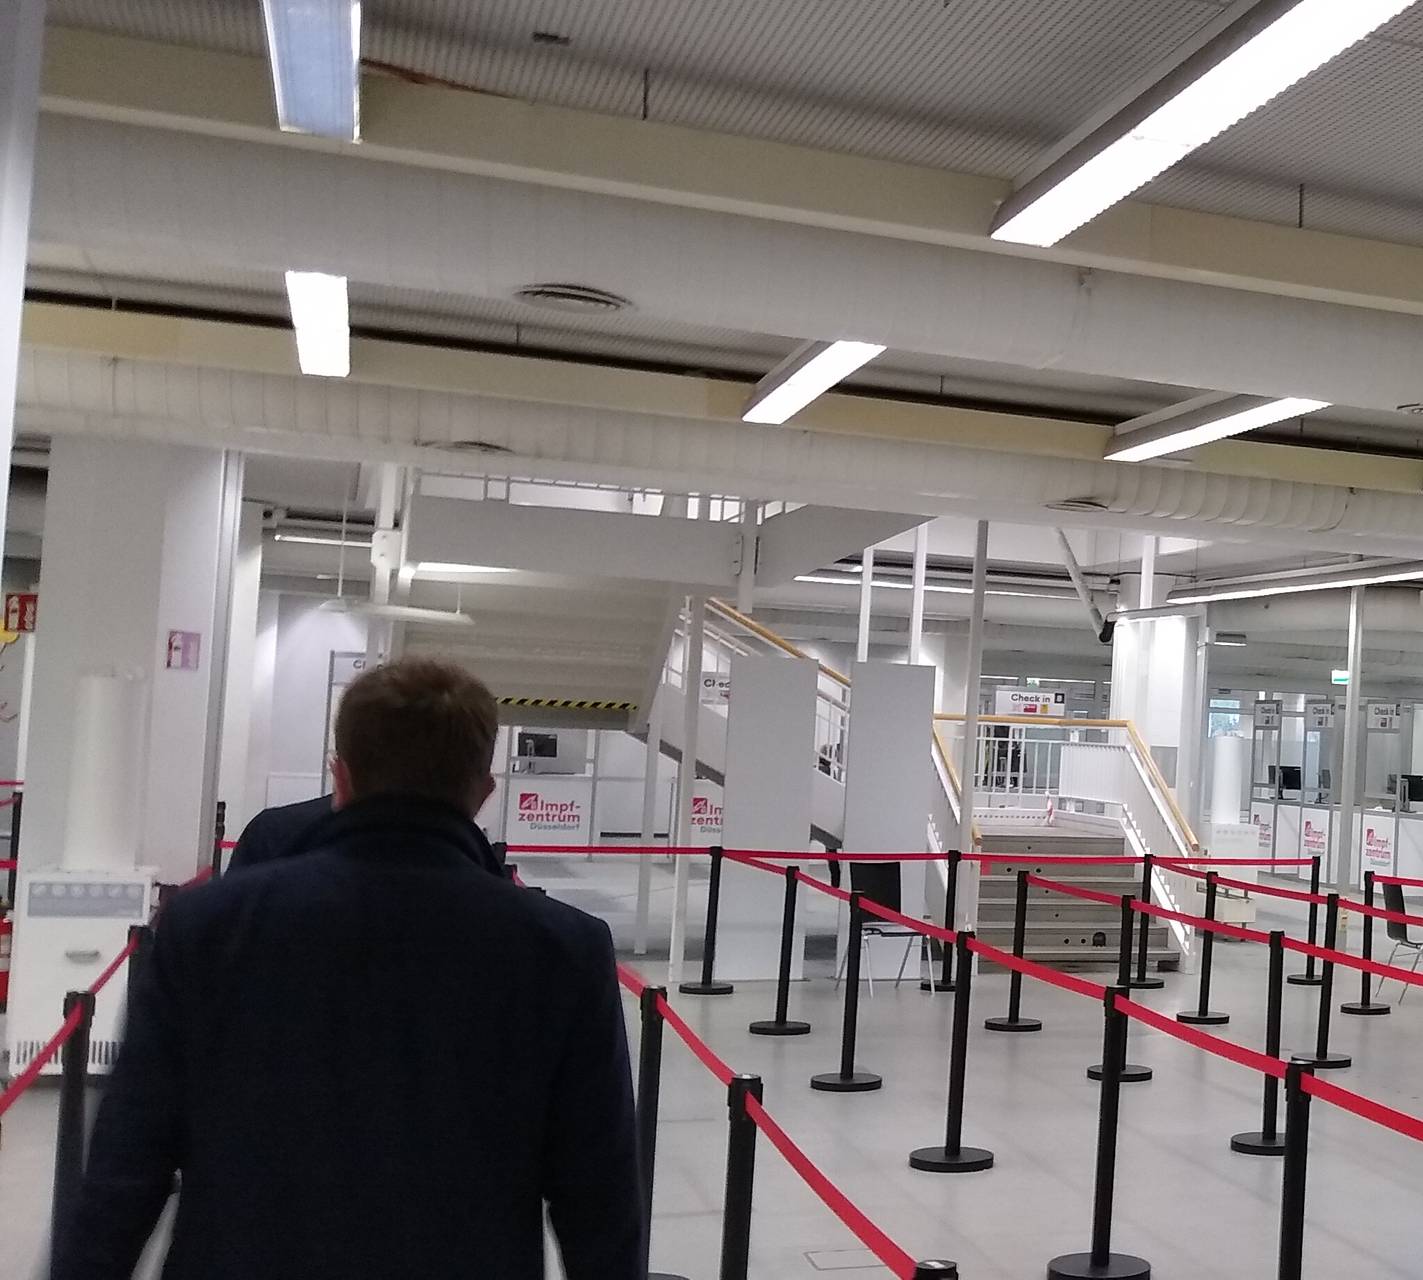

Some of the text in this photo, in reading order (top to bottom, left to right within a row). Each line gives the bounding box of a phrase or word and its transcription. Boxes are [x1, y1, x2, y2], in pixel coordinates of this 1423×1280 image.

[1011, 693, 1040, 702] Check
[540, 800, 581, 813] Impf-
[519, 812, 580, 822] zentrum
